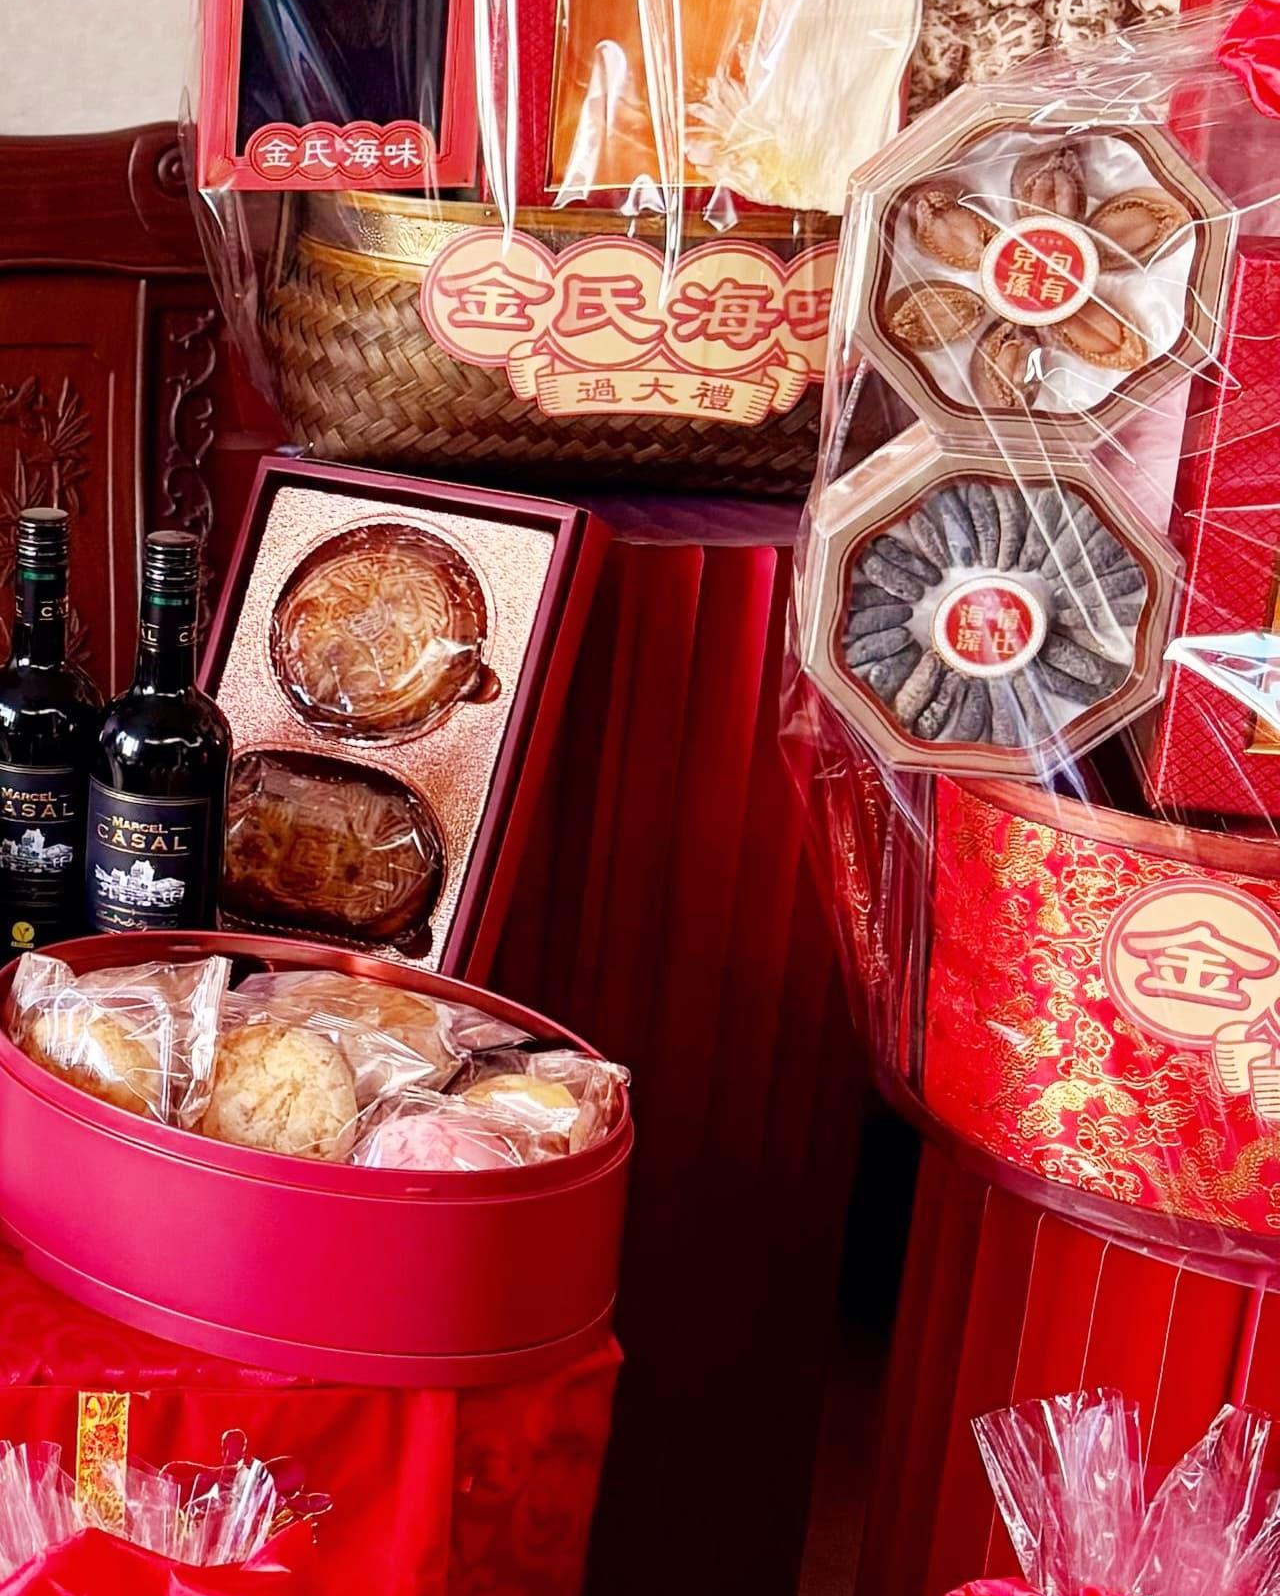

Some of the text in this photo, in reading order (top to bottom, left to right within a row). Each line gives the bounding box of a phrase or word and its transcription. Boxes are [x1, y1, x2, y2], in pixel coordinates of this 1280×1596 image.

[258, 136, 422, 169] 金氏海味
[575, 379, 734, 414] 過大禮
[1, 787, 58, 802] MARCEL
[96, 823, 188, 851] CASAL
[111, 815, 169, 834] MARCEL
